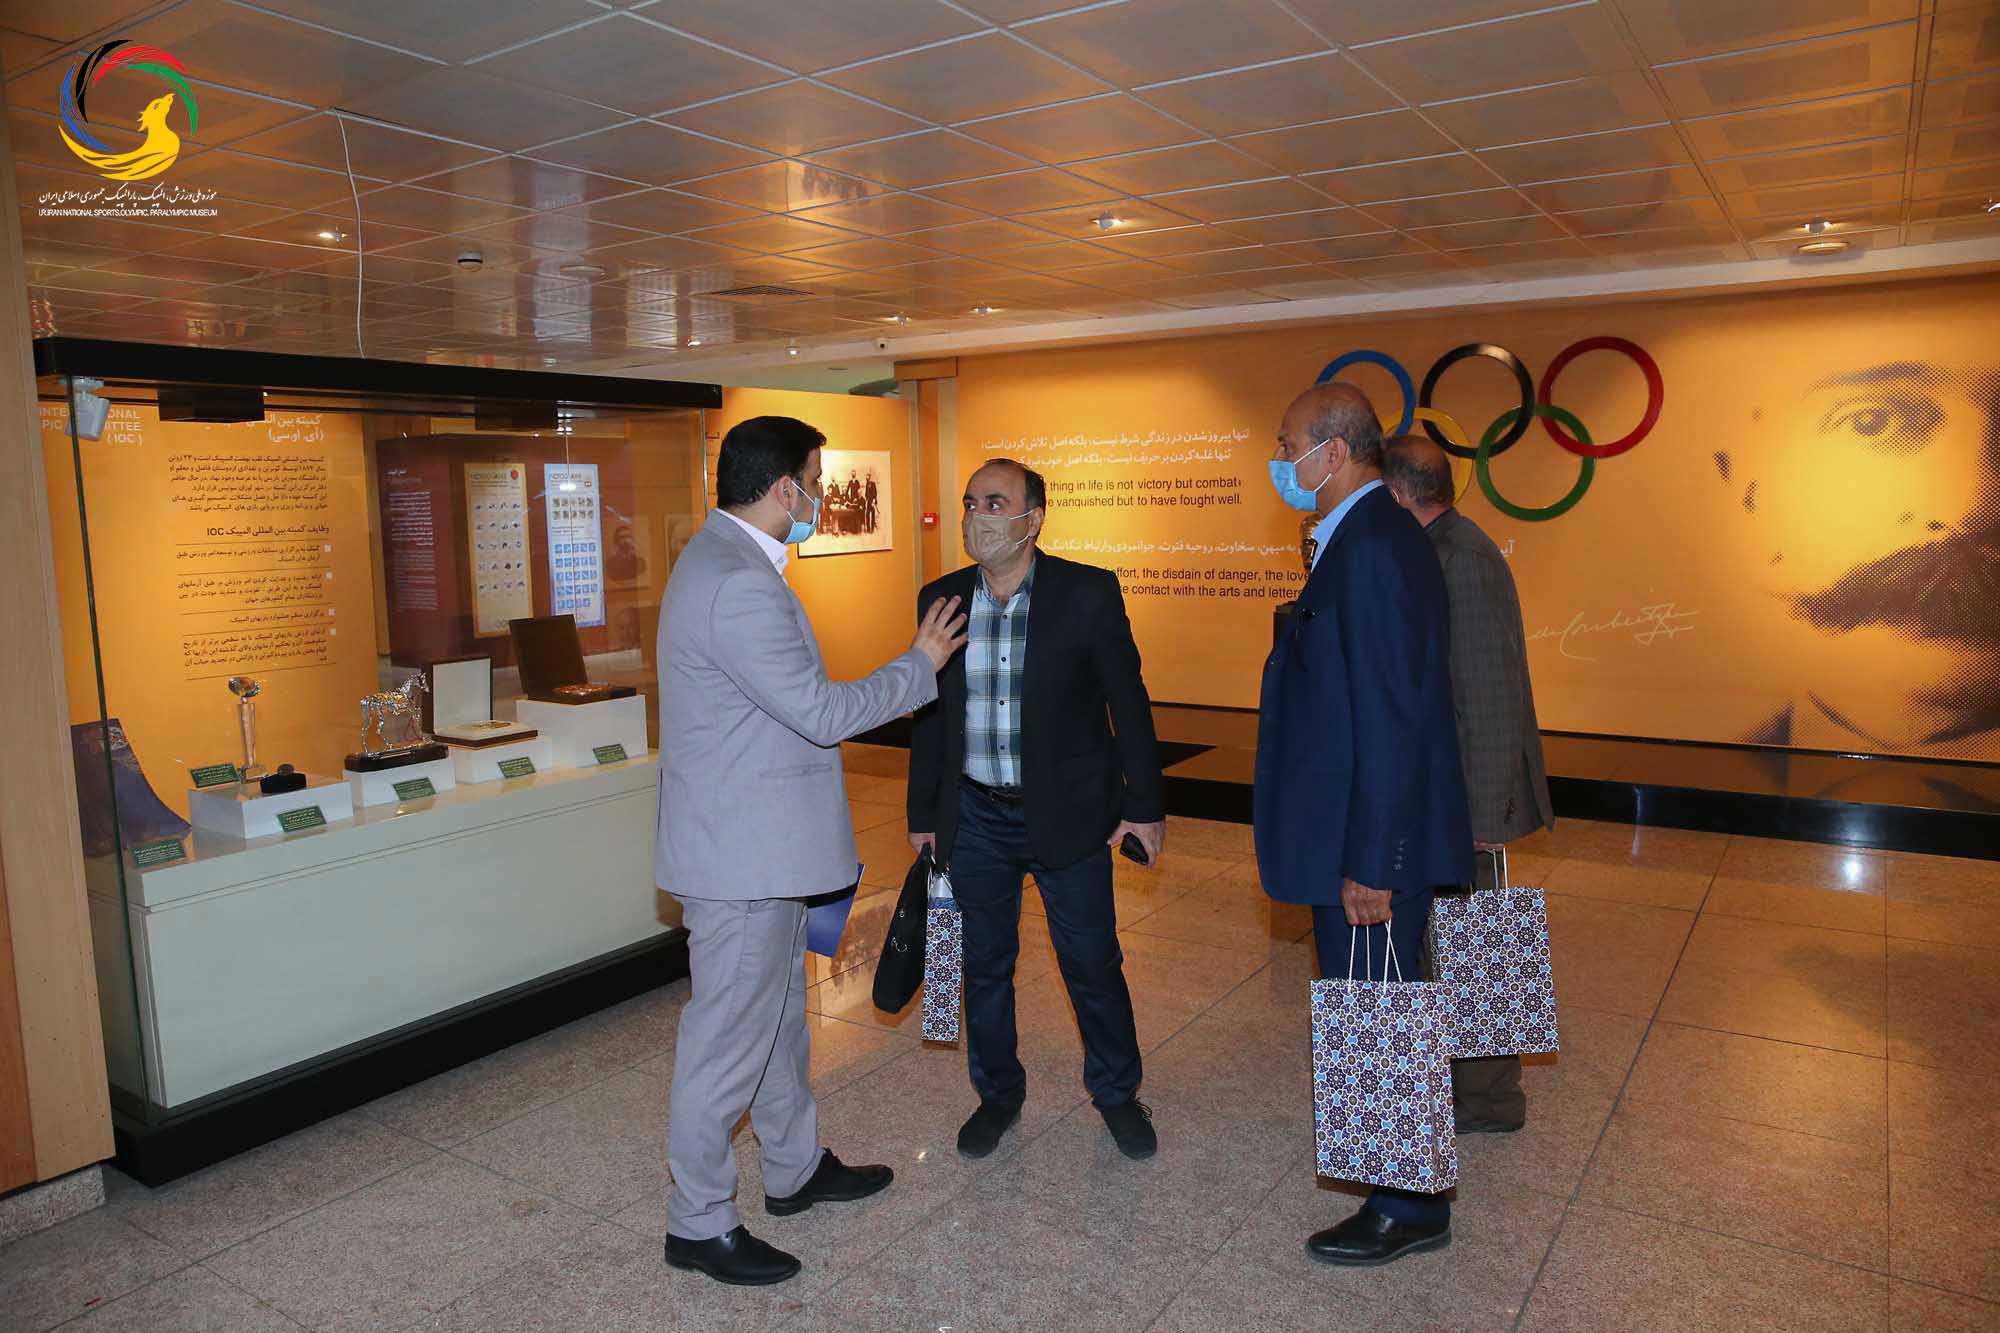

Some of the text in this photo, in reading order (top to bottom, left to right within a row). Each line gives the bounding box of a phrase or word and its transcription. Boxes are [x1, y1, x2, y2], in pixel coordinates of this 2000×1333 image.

[1050, 479, 1074, 494] thing
[1077, 480, 1086, 491] in
[1088, 479, 1103, 491] life
[1106, 479, 1115, 490] is
[1117, 478, 1134, 489] not
[1137, 477, 1172, 492] victory
[1175, 476, 1193, 489] but
[1056, 495, 1114, 510] vanquished
[1116, 494, 1134, 506] but
[1137, 494, 1148, 506] to
[1150, 493, 1177, 506] have
[1179, 492, 1215, 509] fought
[1217, 492, 1242, 505] well.
[206, 527, 225, 536] IOC
[1142, 567, 1160, 579] the
[1162, 567, 1201, 580] disdain
[1203, 567, 1215, 580] of
[1217, 568, 1260, 584] danger,
[1264, 569, 1283, 582] the
[1130, 584, 1169, 596] contact
[1172, 584, 1196, 597] with
[1197, 585, 1216, 597] the
[1219, 586, 1241, 598] arts
[1243, 586, 1265, 599] and
